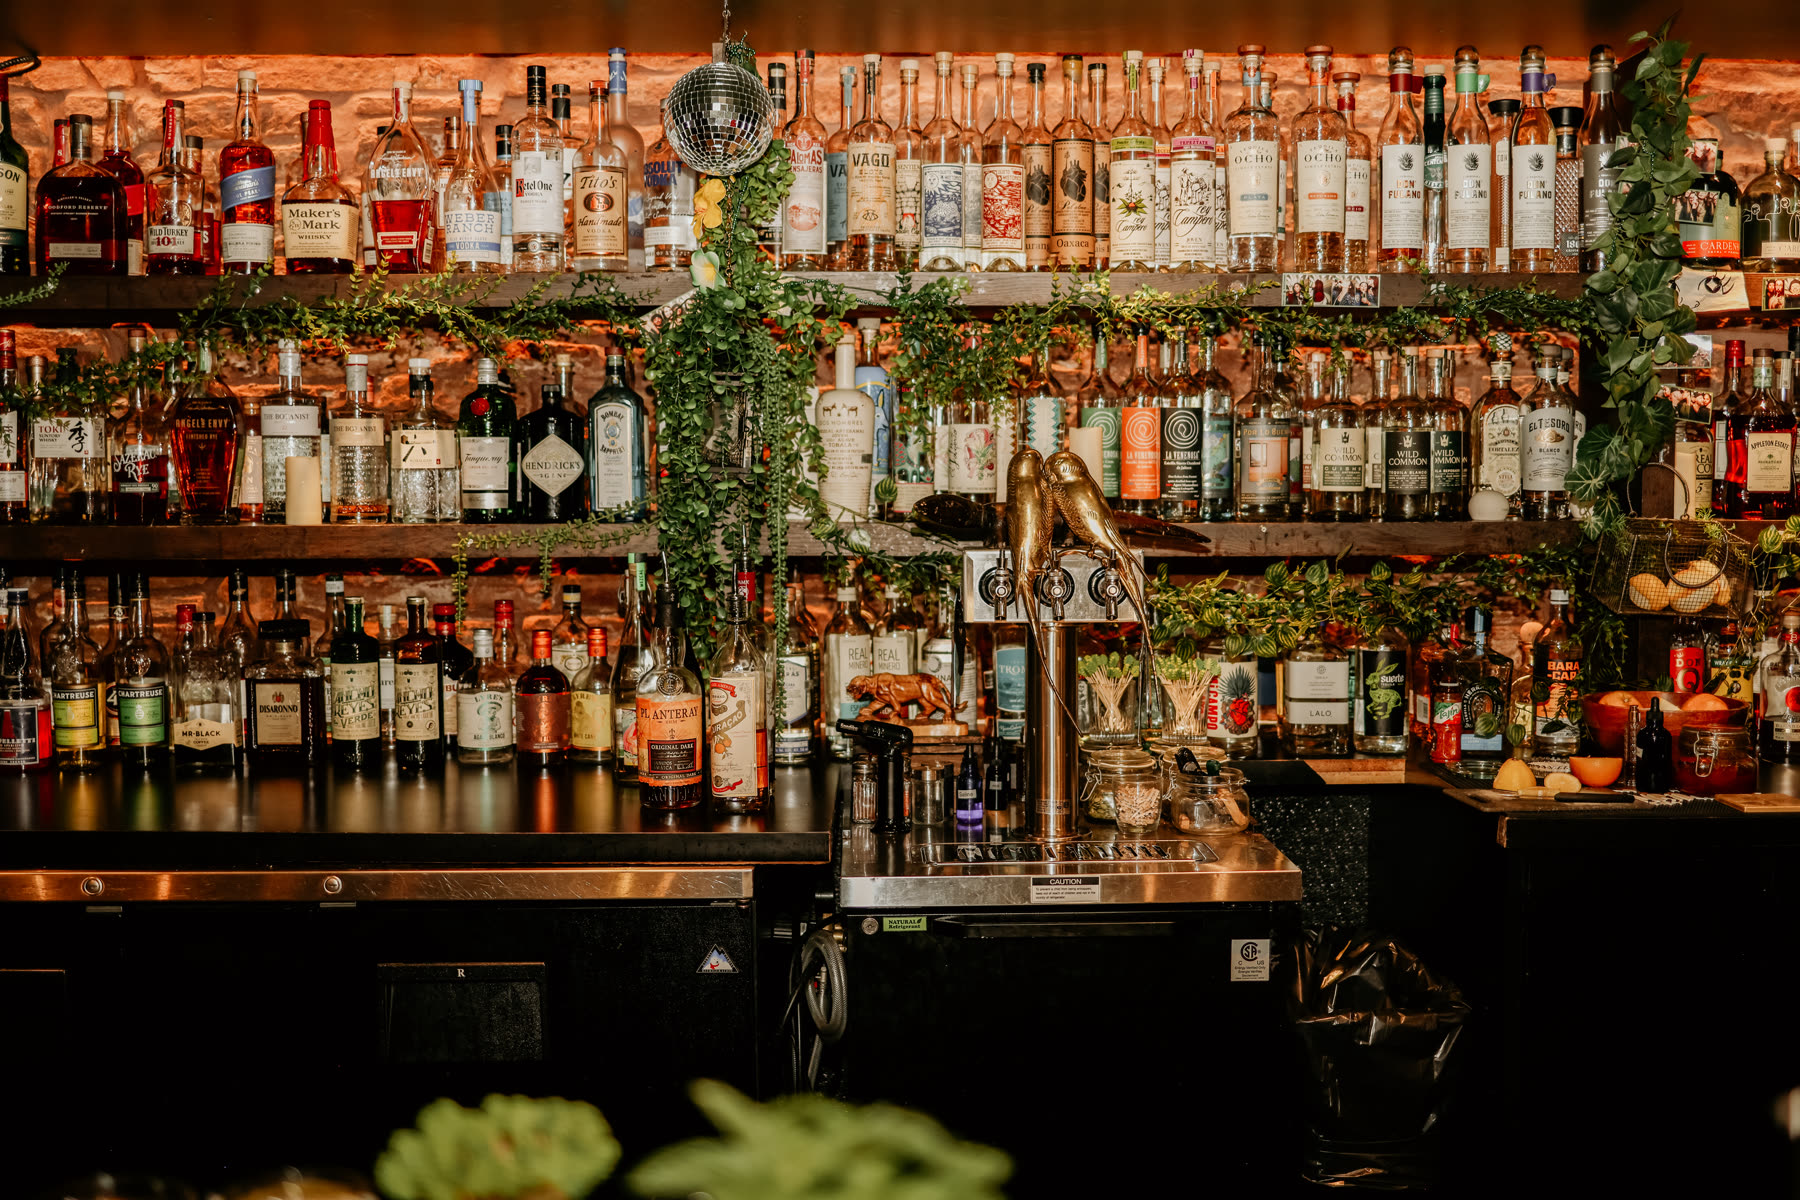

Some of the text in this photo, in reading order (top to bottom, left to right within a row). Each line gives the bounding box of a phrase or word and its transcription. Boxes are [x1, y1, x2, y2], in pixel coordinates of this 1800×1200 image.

[852, 153, 889, 168] VAGO
[1235, 155, 1273, 164] OCHO
[1304, 154, 1342, 163] OCHO
[580, 175, 617, 189] Tito's
[1397, 180, 1415, 188] DON
[1464, 180, 1480, 188] DON
[1527, 180, 1545, 188] DON
[516, 179, 552, 197] Ketel One
[1388, 191, 1421, 199] FULANO
[1455, 191, 1487, 199] FULANO
[1519, 191, 1552, 199] FULANO
[289, 209, 341, 218] Maker's
[445, 214, 494, 223] WEBER
[578, 216, 622, 227] Handmade
[303, 220, 340, 229] Mark
[446, 224, 494, 233] RANCH
[163, 227, 189, 237] TURKEY
[456, 242, 480, 250] VODKA
[1056, 239, 1089, 247] Oaxaca
[601, 410, 624, 422] BOMBAY
[1529, 423, 1537, 432] EL
[68, 421, 88, 453] 季
[600, 444, 625, 455] SAPPHIRE
[1751, 440, 1790, 450] APPLETON ESTATE
[1127, 451, 1133, 459] LA
[1166, 451, 1199, 459] LA VENENOSA
[1435, 449, 1454, 457] WILD
[114, 450, 157, 473] SAZERAC
[525, 462, 580, 470] HENDRICK'S
[1388, 458, 1427, 466] COMMON
[124, 463, 149, 482] RYE
[849, 648, 868, 660] REAL
[878, 649, 900, 661] REAL
[849, 661, 868, 669] MINERO
[878, 662, 900, 670] MINERO
[1547, 661, 1580, 670] BARA
[1675, 658, 1701, 667] DON
[1381, 674, 1404, 683] suerte
[1677, 668, 1700, 693] Q
[118, 689, 162, 698] CHARTREUSE
[259, 705, 298, 713] DISARONNO
[334, 701, 375, 718] REYES
[640, 705, 698, 719] PLANTERAY
[1207, 690, 1218, 730] CAMPO
[1439, 706, 1459, 719] Tajín
[341, 713, 373, 729] VERDE
[457, 968, 465, 977] R
